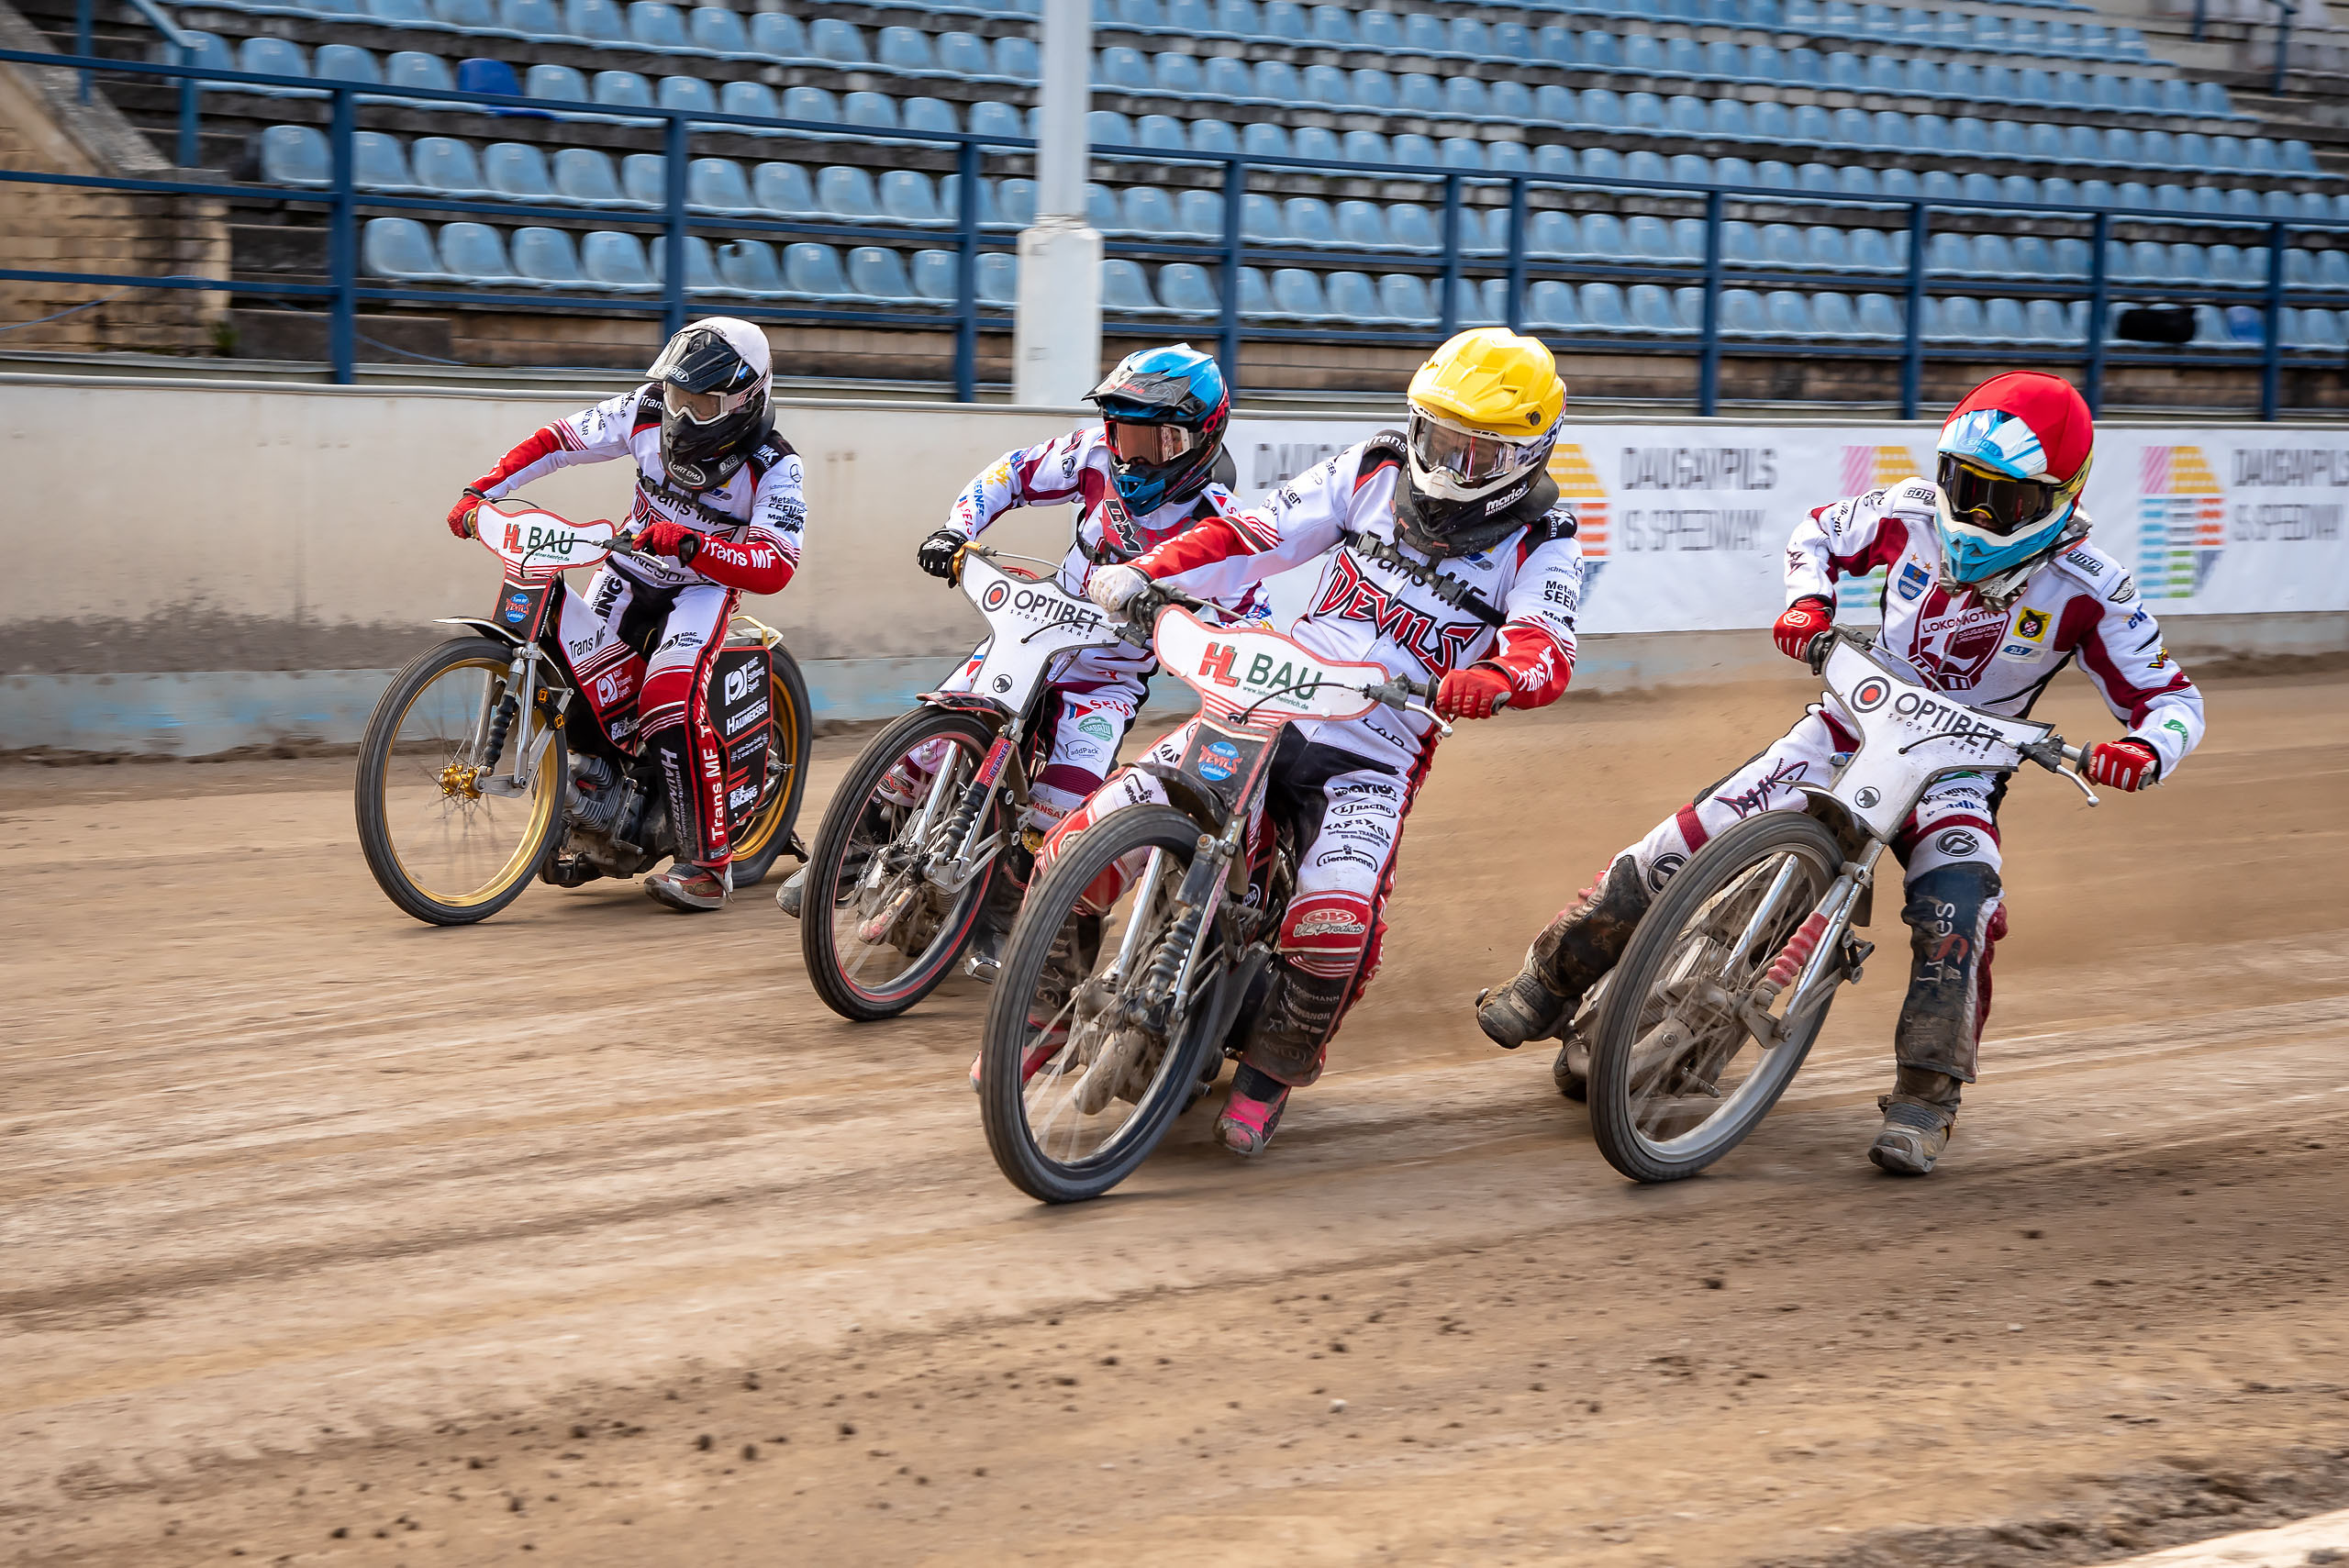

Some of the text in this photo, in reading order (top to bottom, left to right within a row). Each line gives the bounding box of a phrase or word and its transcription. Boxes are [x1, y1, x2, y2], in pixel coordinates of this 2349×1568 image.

[2232, 449, 2349, 486] DAUGAVPIL
[528, 526, 575, 555] BAU
[701, 537, 777, 569] Trans MF
[1014, 589, 1103, 633] OPTIBET
[1313, 548, 1488, 683] DEVILS
[569, 636, 594, 660] Trans
[1246, 652, 1323, 701] BAU
[1089, 699, 1130, 717] SELS
[1895, 693, 2005, 752] OPTIBET
[703, 749, 721, 778] MF
[989, 742, 1011, 778] BERNER
[1070, 747, 1099, 756] addPack
[1197, 744, 1243, 774] DEVILS
[711, 782, 725, 841] Trans
[1340, 804, 1391, 815] LJ RACING
[1323, 855, 1374, 870] Lienemann
